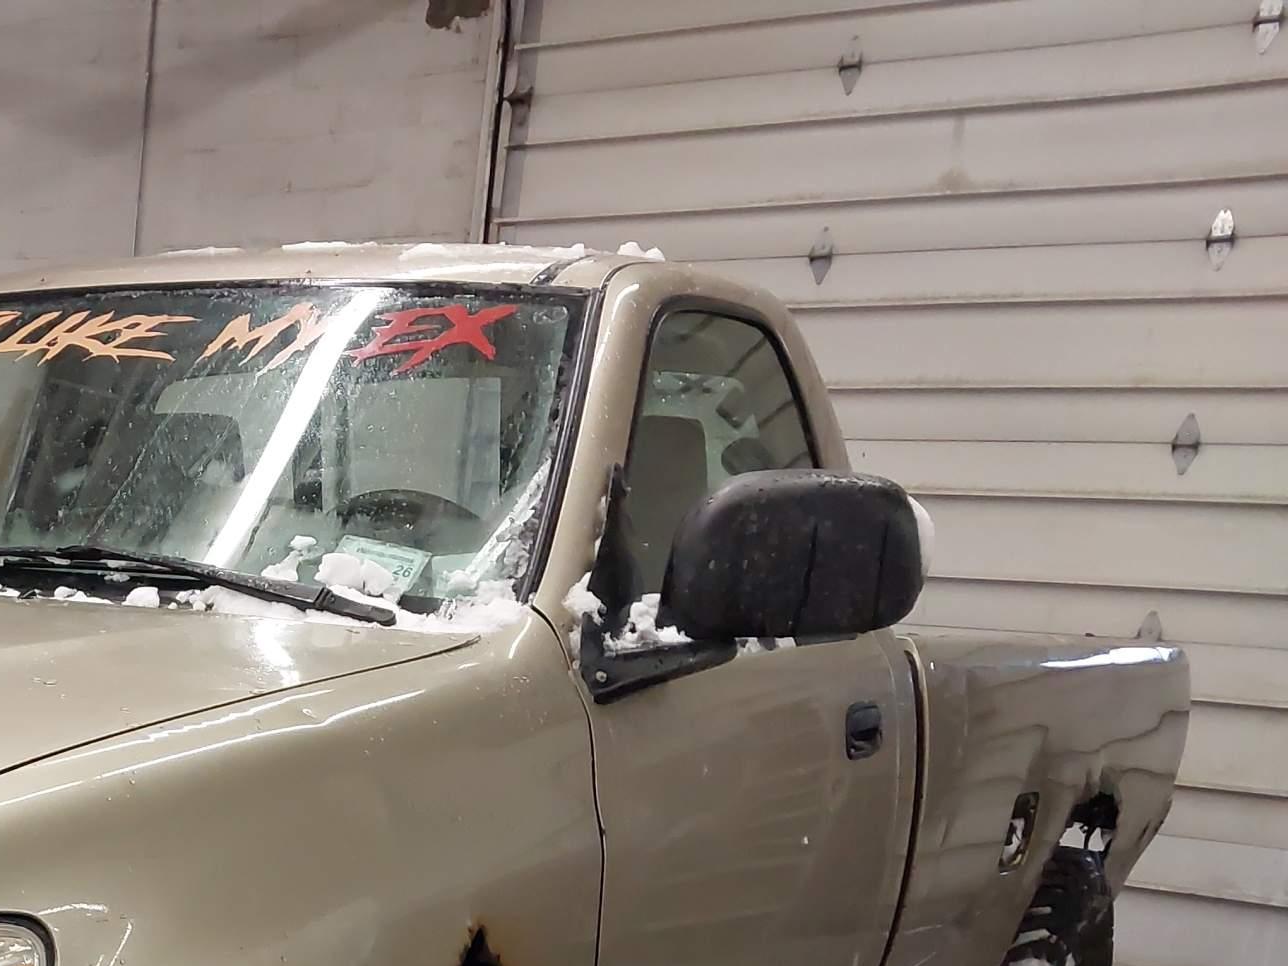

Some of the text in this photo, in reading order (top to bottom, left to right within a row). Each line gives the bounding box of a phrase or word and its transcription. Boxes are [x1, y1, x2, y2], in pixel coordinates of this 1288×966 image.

[195, 302, 329, 378] MY
[345, 304, 521, 377] EX
[393, 564, 414, 578] 26
